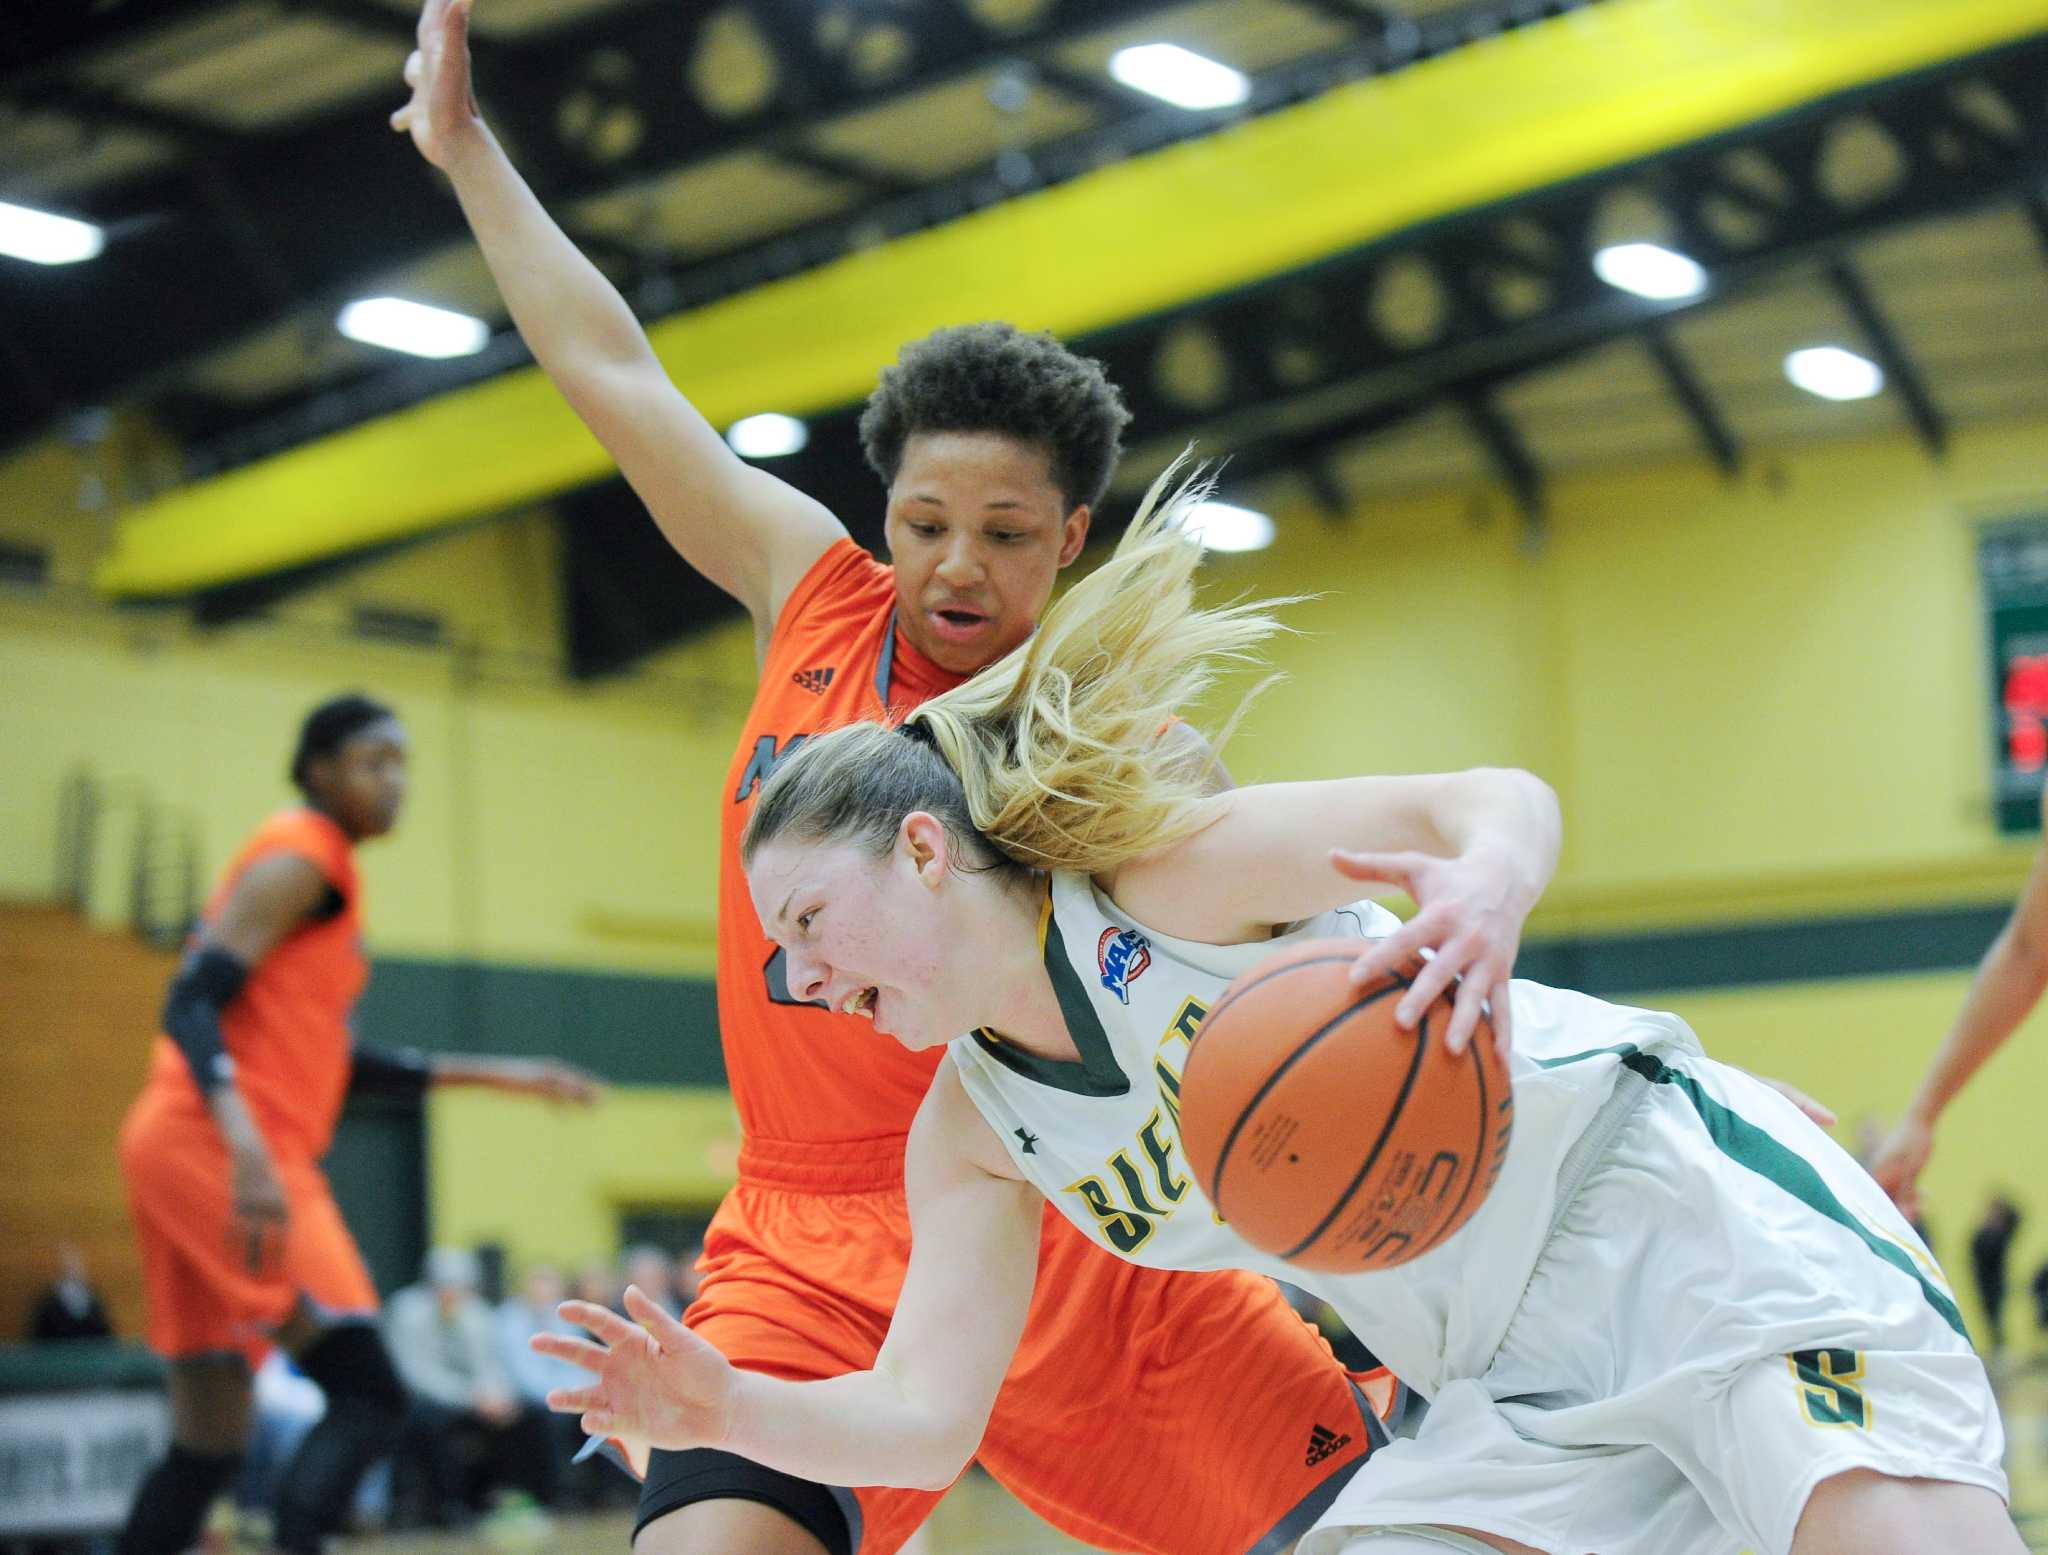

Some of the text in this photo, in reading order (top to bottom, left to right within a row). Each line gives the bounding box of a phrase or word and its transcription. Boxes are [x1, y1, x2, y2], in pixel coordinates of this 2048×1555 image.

[1062, 994, 1211, 1256] SIE
[1785, 1347, 1873, 1432] S
[1304, 1433, 1352, 1467] adidas
